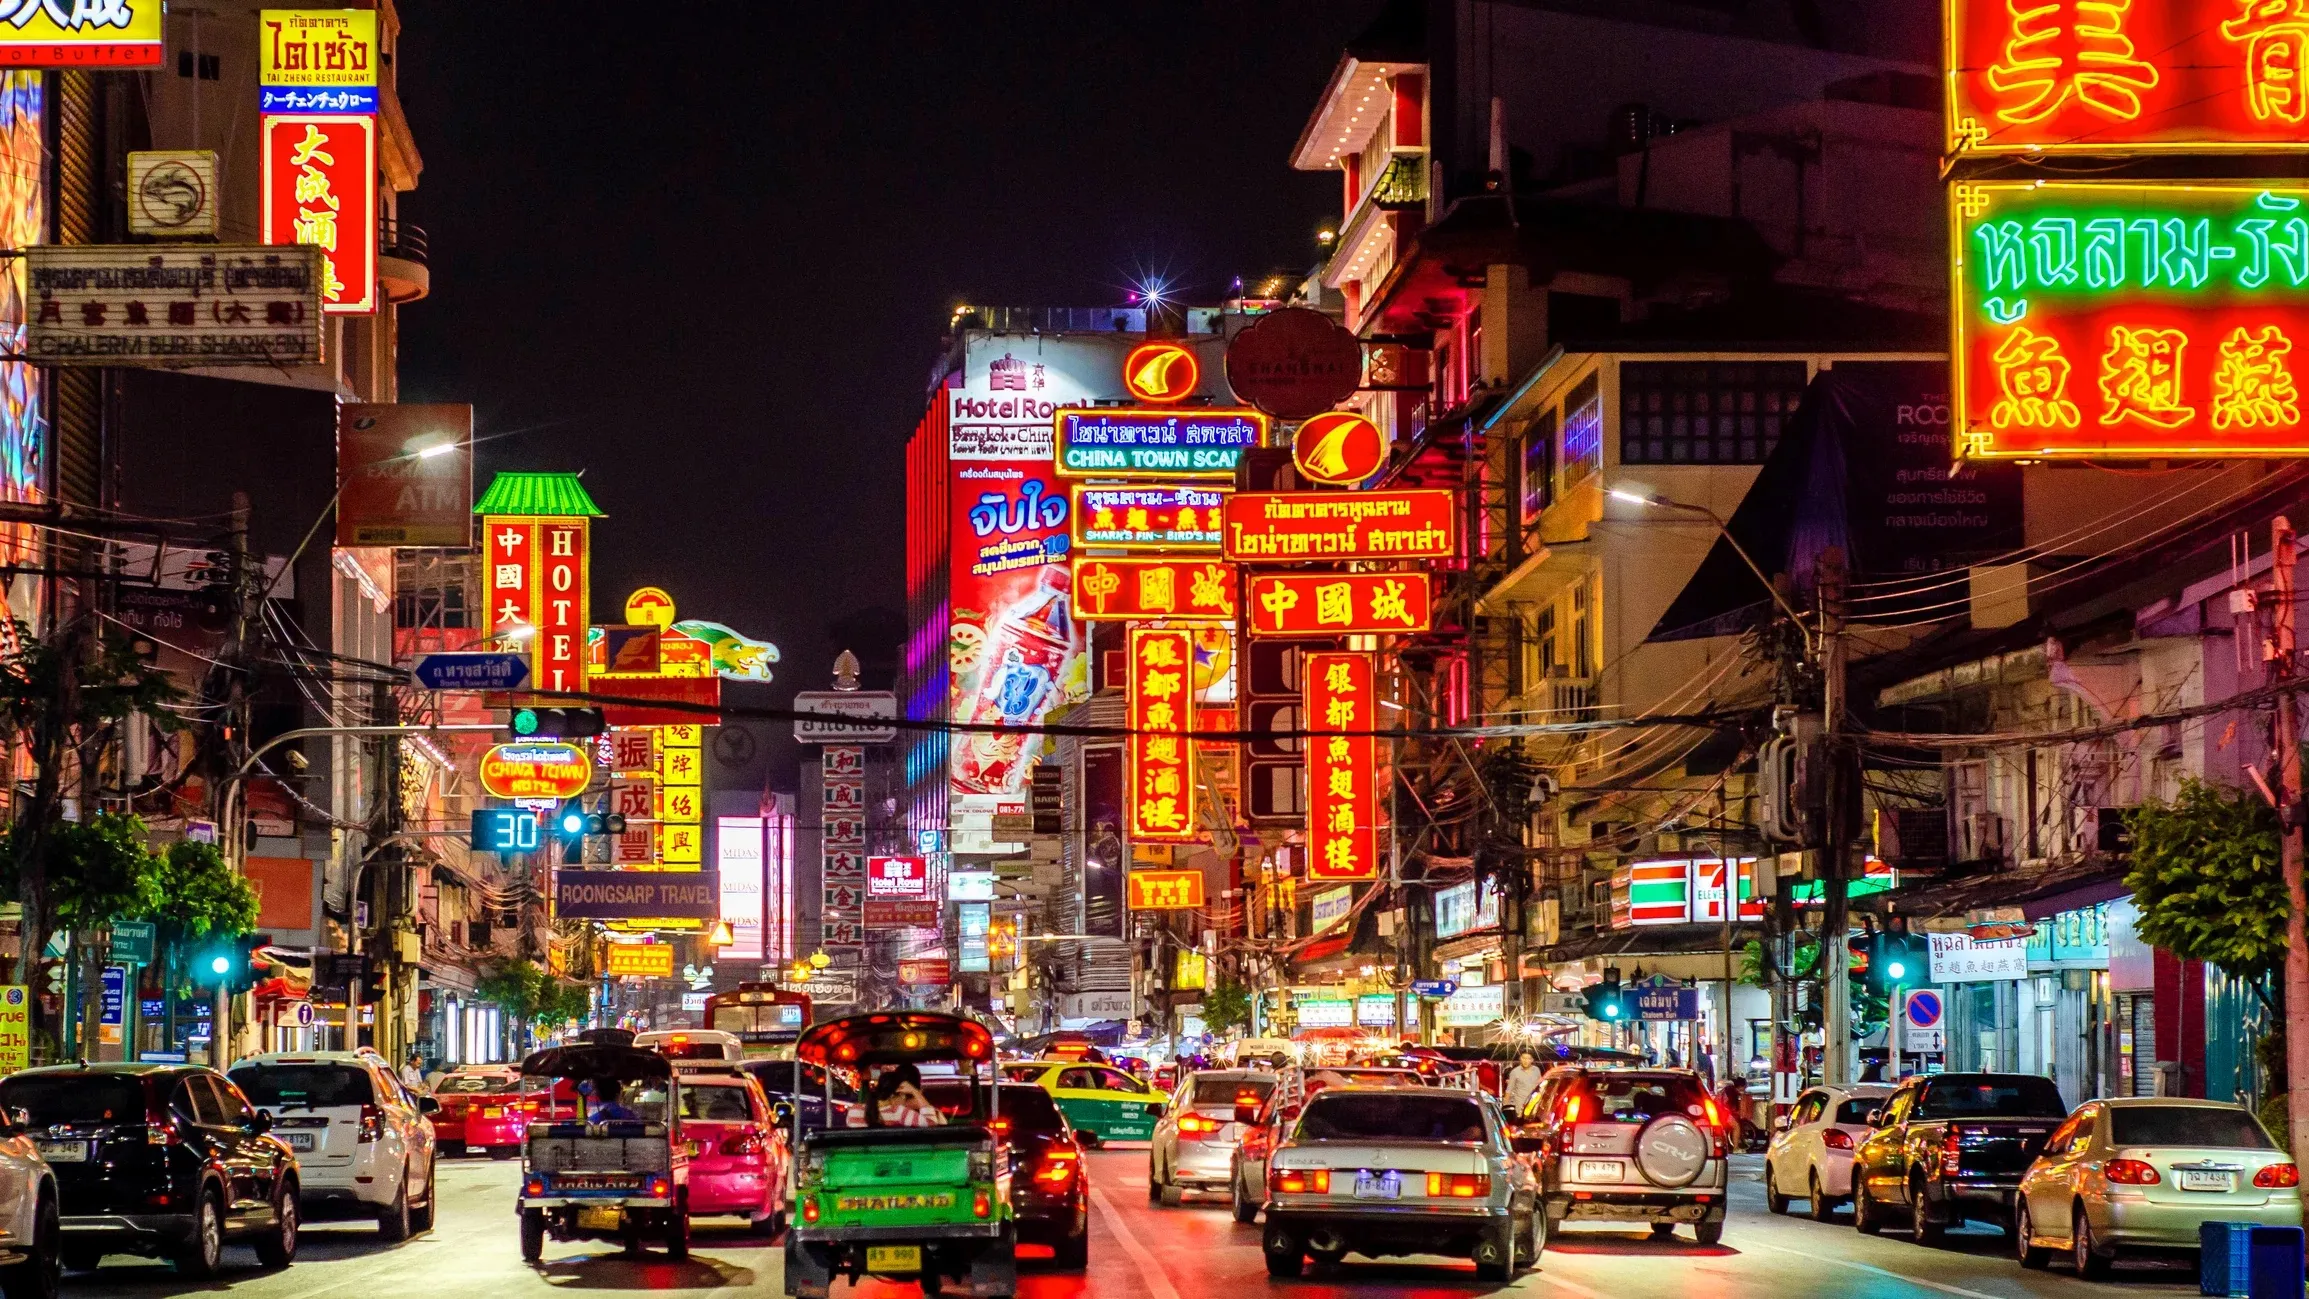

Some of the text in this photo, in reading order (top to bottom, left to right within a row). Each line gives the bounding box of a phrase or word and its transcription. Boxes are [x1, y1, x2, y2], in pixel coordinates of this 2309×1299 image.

[53, 47, 150, 60] Buffet
[267, 73, 371, 83] TAI ZHENG RESTAURANT
[37, 335, 142, 355] CHALERM
[955, 397, 1018, 418] Hotel
[1897, 405, 1950, 425] ROO
[1068, 415, 1253, 444] ไชน่าทาวน์ สกาล่า
[1066, 450, 1127, 467] CHINA
[1131, 451, 1188, 467] TOWN
[396, 485, 461, 511] ATM
[969, 480, 1068, 537] จับใจ
[1044, 534, 1069, 555] 10
[1206, 531, 1222, 541] NE
[1231, 521, 1446, 554] ไชน่าทาวน์ สกาล่า
[1083, 563, 1233, 614] 中國城
[551, 529, 574, 693] HOTEL
[1260, 578, 1415, 630] 中國城
[487, 763, 584, 779] CHINA TOWN
[1323, 662, 1359, 872] 銀都魚翅酒樓
[497, 815, 537, 847] 30
[723, 849, 758, 859] MIDAS
[833, 750, 855, 940] 和成興大金行
[561, 884, 716, 904] ROONGSARP TRAVEL
[723, 883, 758, 893] MIDAS
[1698, 890, 1728, 900] ELEVE
[723, 916, 758, 926] MIDAS
[1444, 984, 1452, 994] 2
[1639, 991, 1679, 1010] เฉลิมบุรี
